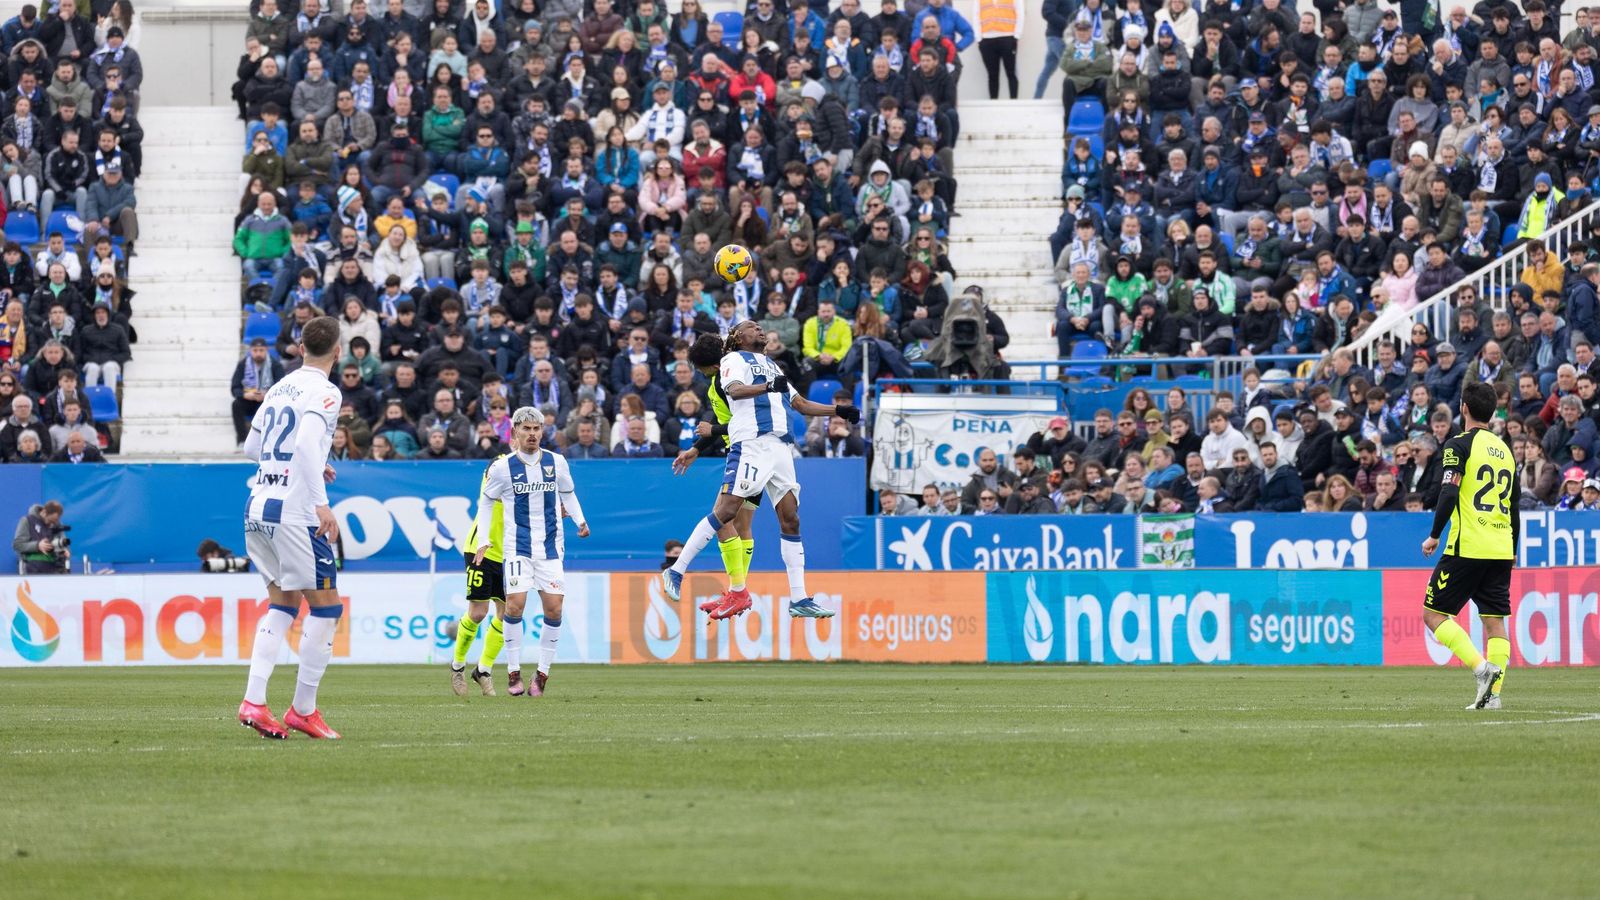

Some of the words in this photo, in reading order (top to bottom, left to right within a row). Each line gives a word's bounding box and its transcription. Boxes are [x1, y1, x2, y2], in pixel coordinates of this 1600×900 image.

[260, 405, 296, 461] 22
[1486, 446, 1505, 460] ISCO
[513, 481, 556, 494] Ontime
[744, 463, 759, 482] 17
[1473, 464, 1512, 515] 22
[941, 520, 1124, 570] CaixaBank
[1230, 513, 1369, 569] Lowi
[467, 569, 484, 588] 15
[509, 560, 521, 577] 11
[858, 611, 953, 651] seguros
[1064, 591, 1231, 662] nara
[1249, 613, 1355, 653] seguros
